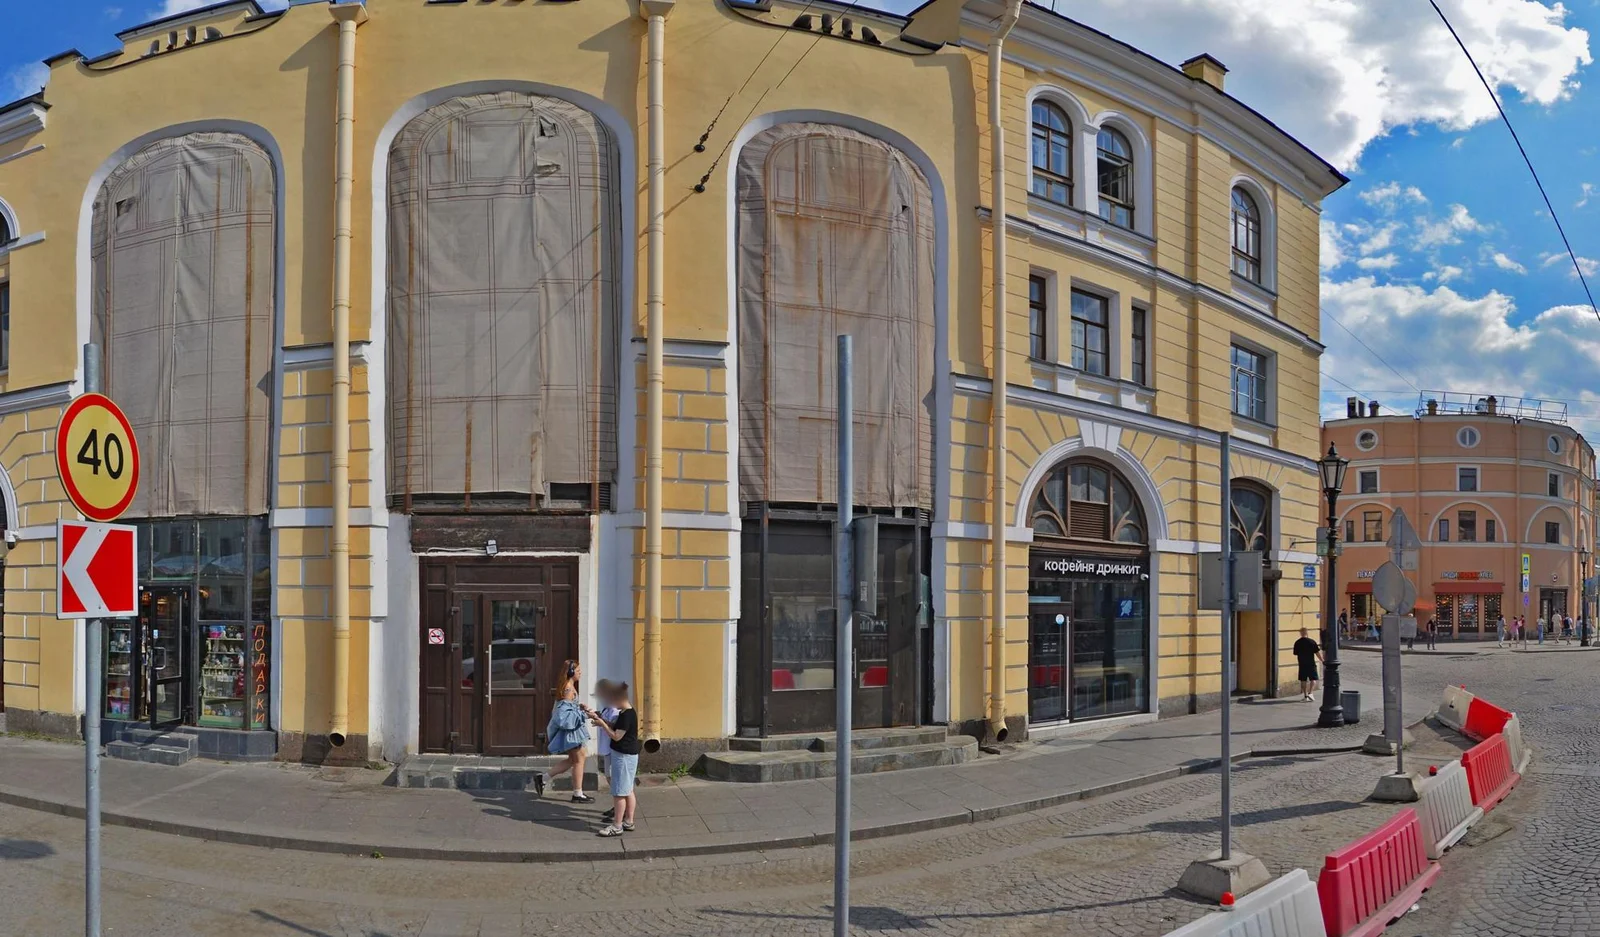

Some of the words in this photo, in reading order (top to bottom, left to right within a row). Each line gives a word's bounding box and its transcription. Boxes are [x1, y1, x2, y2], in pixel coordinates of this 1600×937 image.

[77, 428, 124, 480] 40
[1044, 558, 1095, 575] кофейня
[1096, 563, 1141, 577] дринкит
[254, 624, 266, 724] ПОДАРКИ
